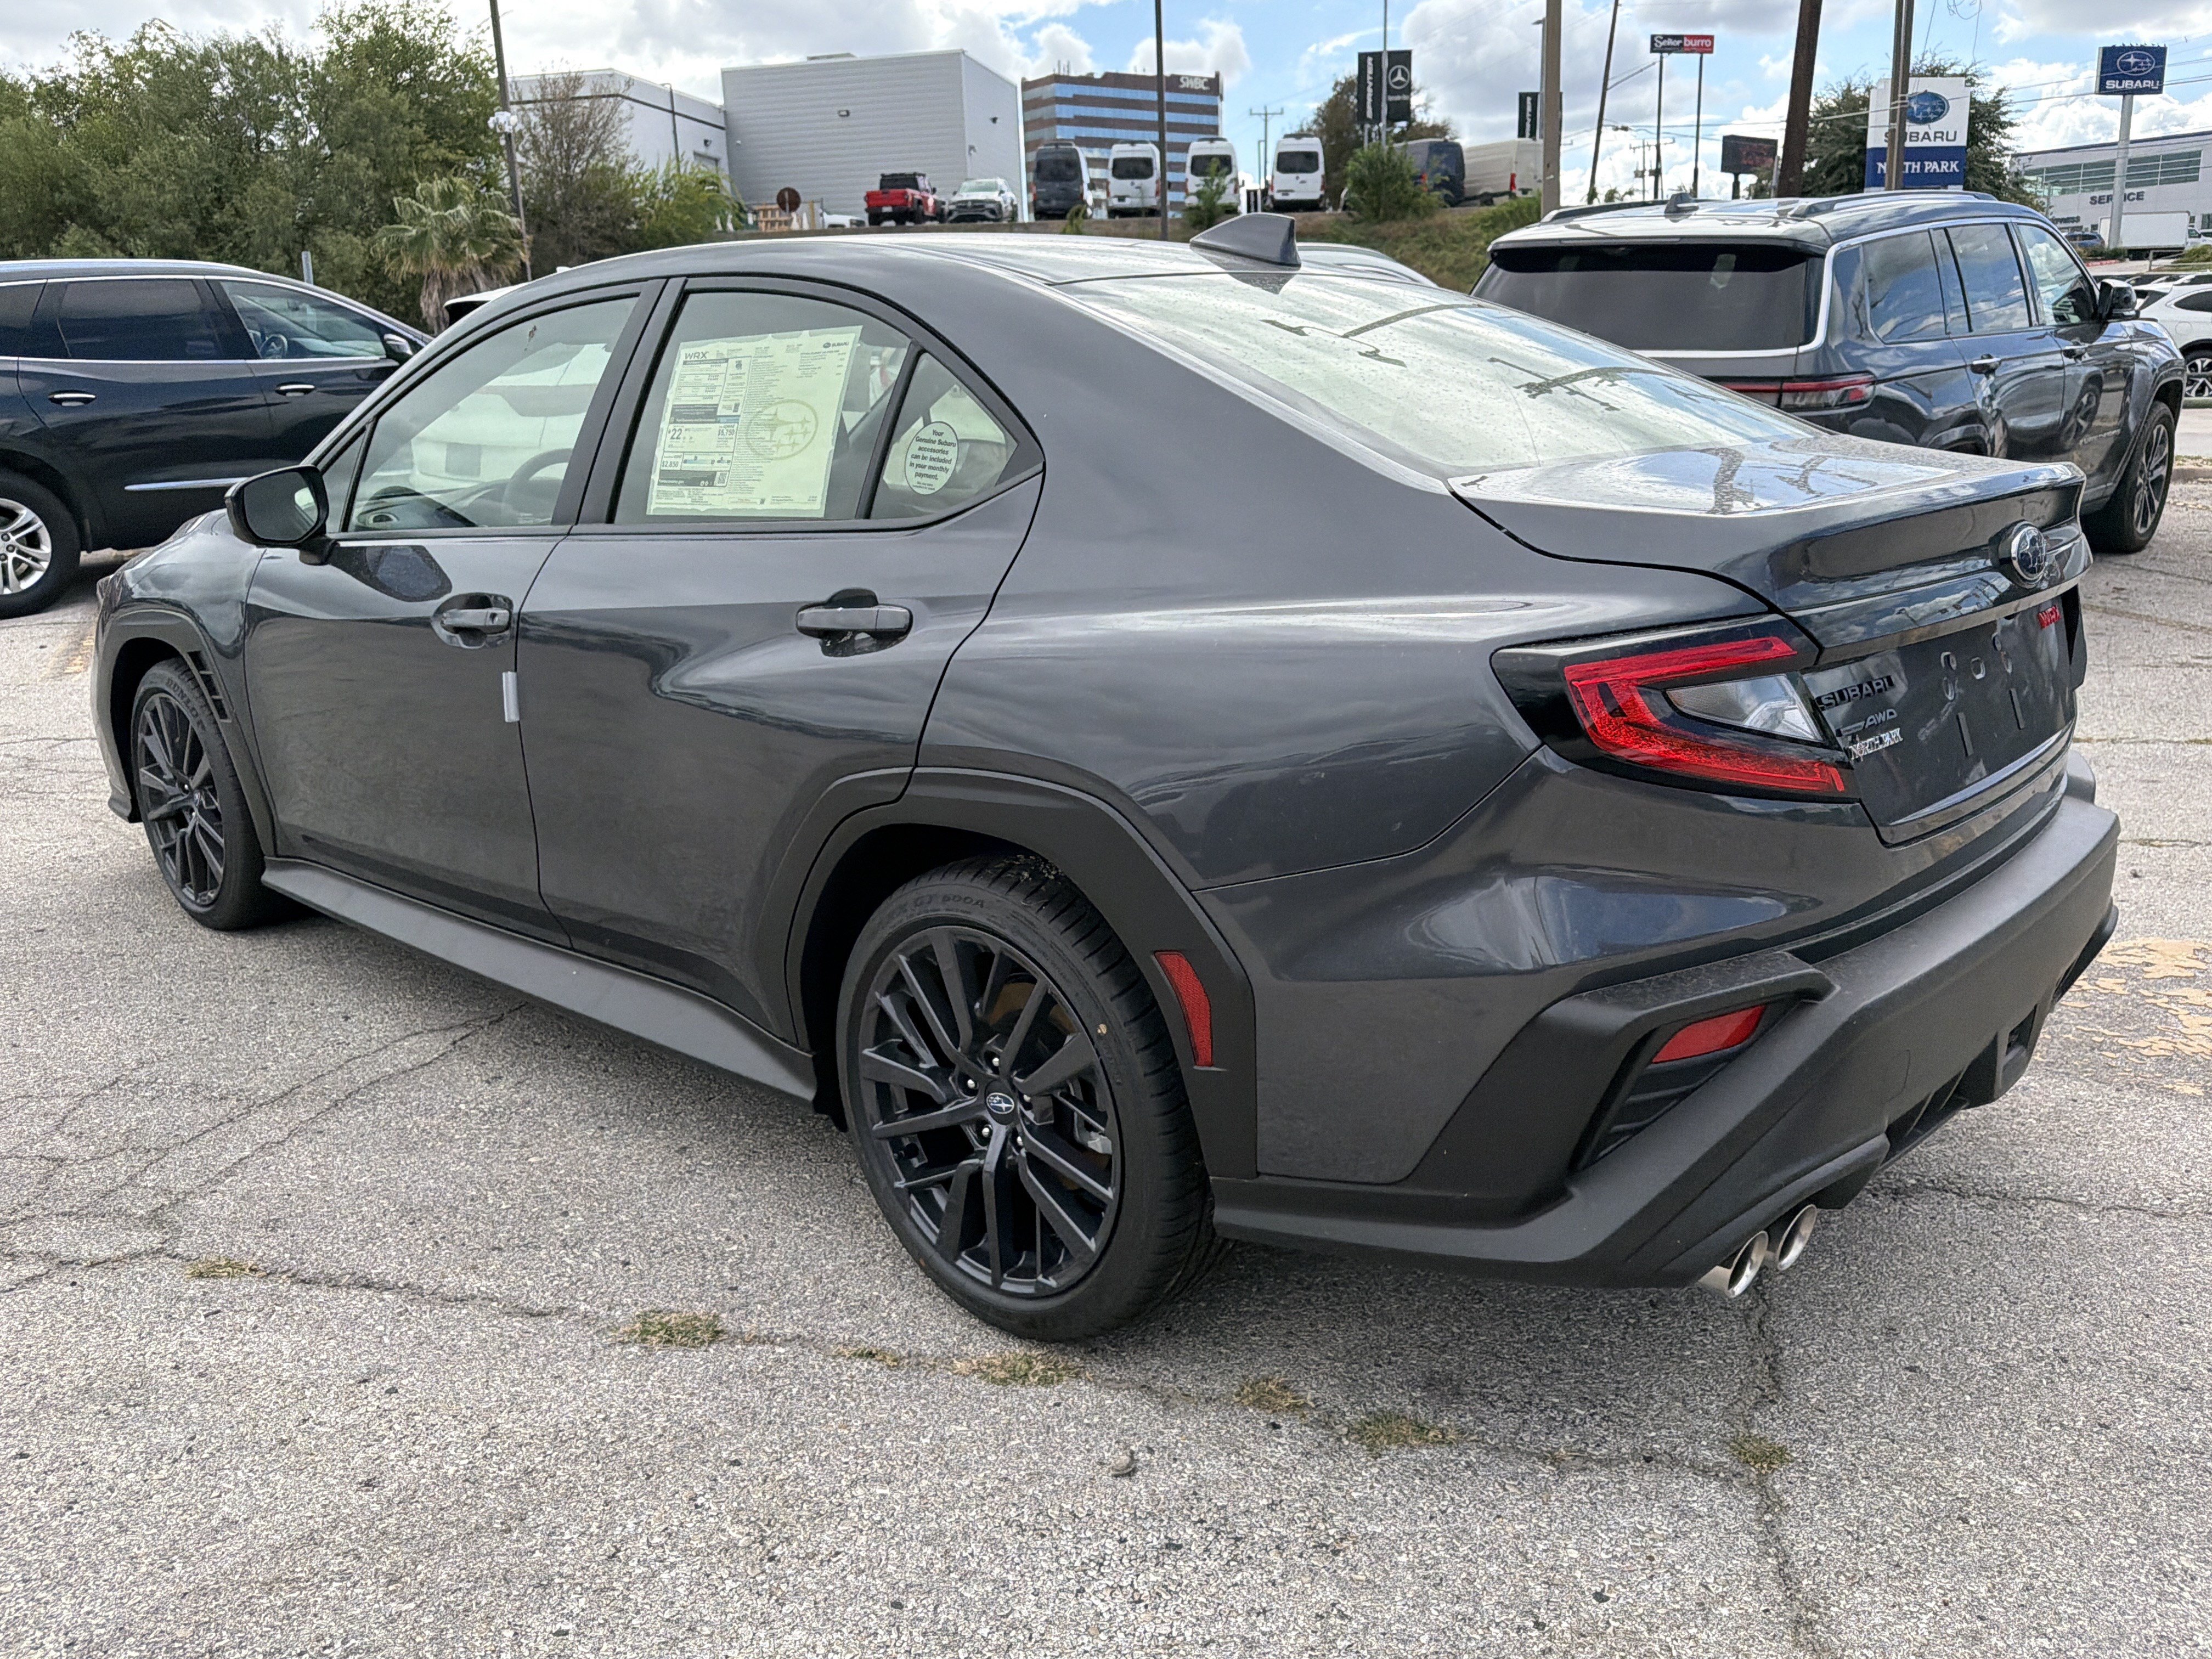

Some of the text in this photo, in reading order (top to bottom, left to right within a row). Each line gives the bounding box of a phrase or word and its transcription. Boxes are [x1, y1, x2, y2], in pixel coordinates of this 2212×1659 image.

[1683, 37, 1712, 47] burro
[2106, 80, 2159, 89] SUBARU
[1876, 160, 1960, 174] NTH PARK
[2089, 191, 2145, 205] SERICE
[670, 428, 682, 440] 22
[916, 436, 957, 448] Genuine Subaru
[917, 445, 949, 455] accessories
[929, 455, 952, 465] included
[927, 464, 950, 474] monthly
[915, 472, 939, 481] payment.
[2038, 606, 2061, 628] WRX
[1865, 708, 1898, 728] AWD
